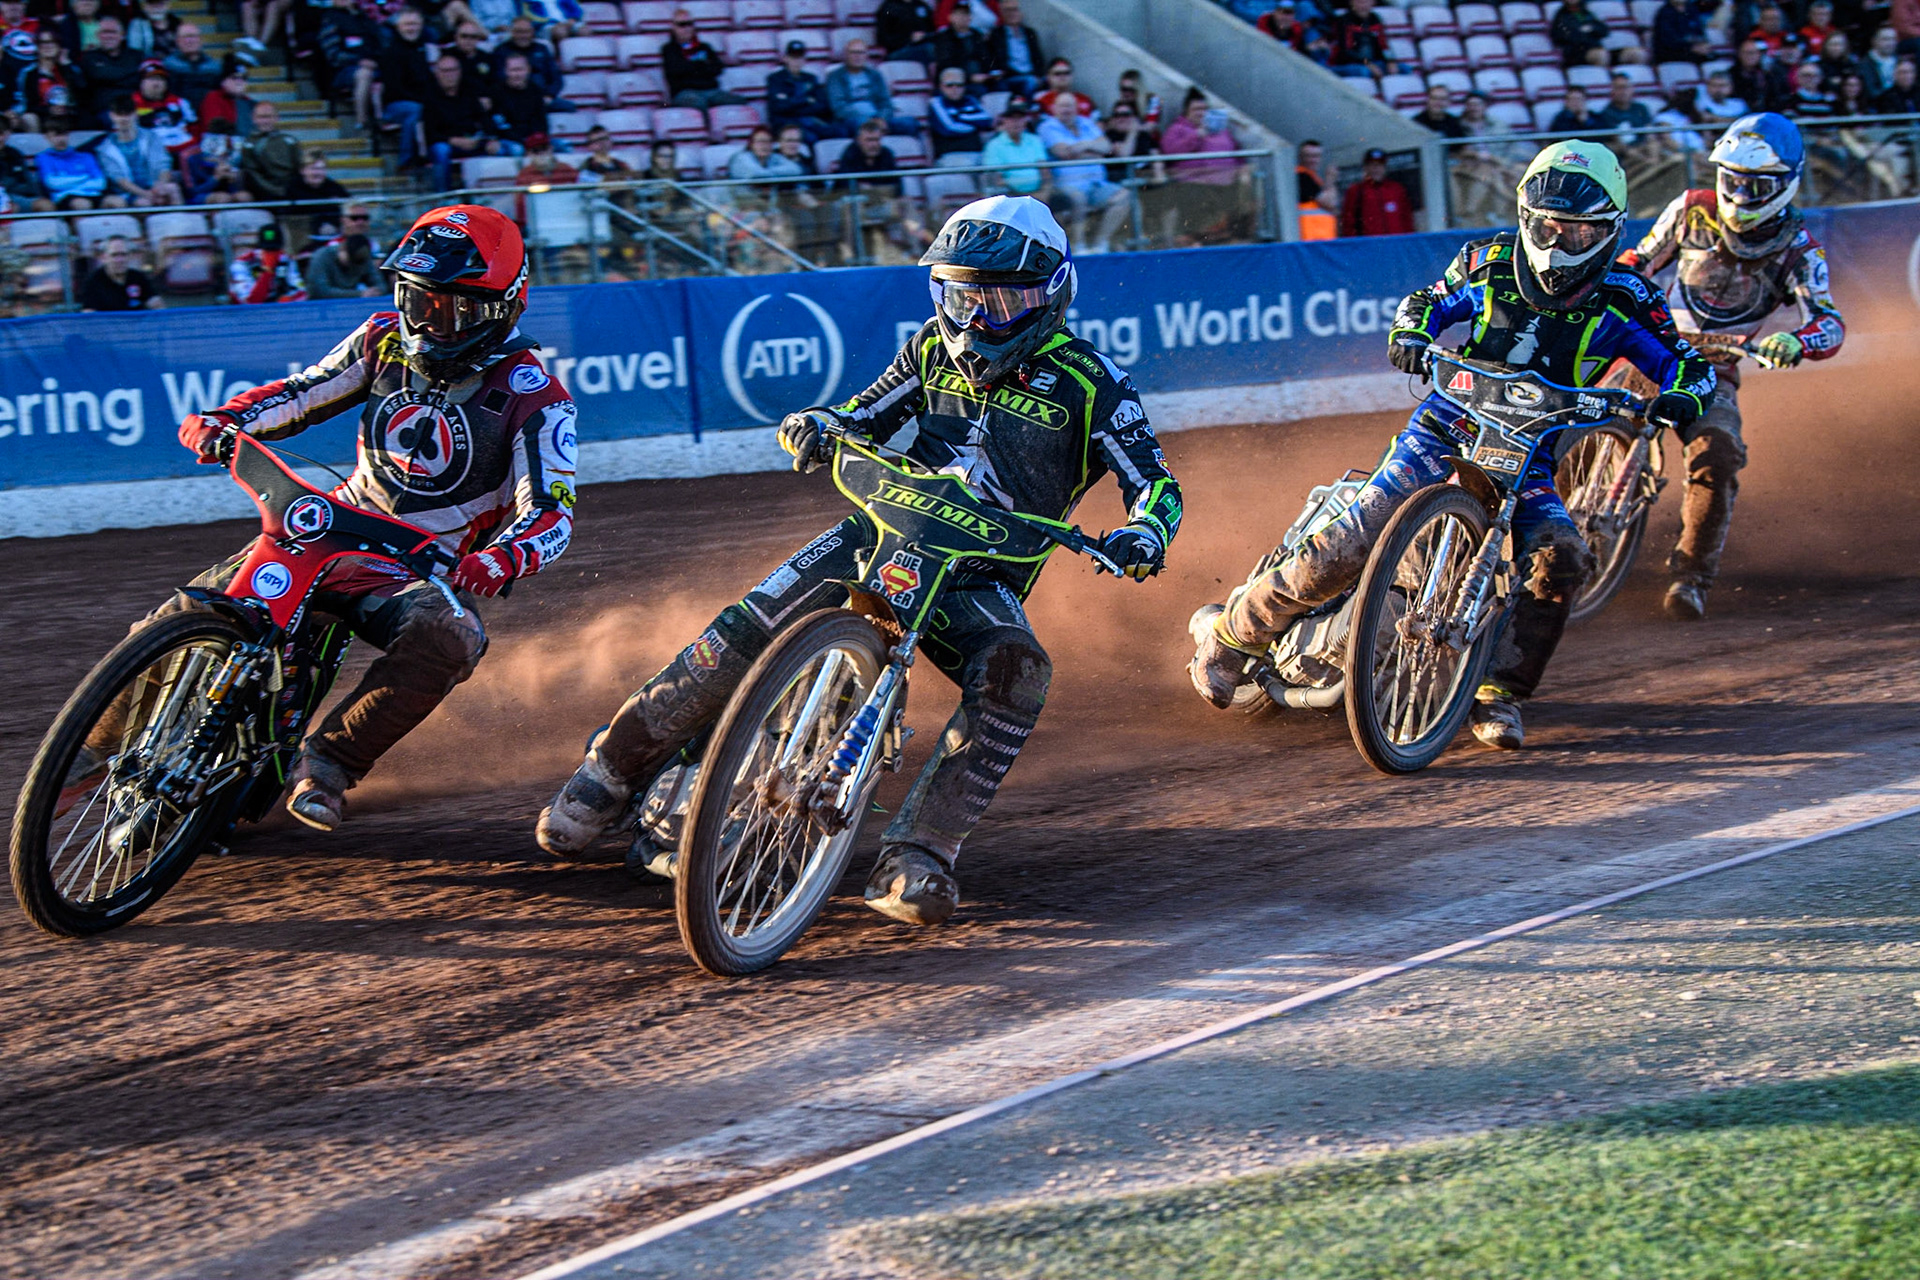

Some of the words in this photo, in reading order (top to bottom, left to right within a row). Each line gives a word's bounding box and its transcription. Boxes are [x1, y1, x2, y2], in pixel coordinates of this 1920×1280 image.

[1469, 244, 1515, 271] LUCA
[1155, 292, 1293, 349] World
[1304, 288, 1400, 337] Clas
[531, 336, 688, 396] Travel
[743, 336, 822, 379] ATPI
[1030, 372, 1056, 392] 2
[994, 387, 1058, 424] MIX
[384, 393, 421, 416] BELLE
[447, 415, 467, 451] ACES
[1404, 435, 1426, 456] STEVE
[1481, 449, 1524, 461] WATLING
[1476, 455, 1519, 471] JCB
[883, 485, 938, 511] TRU
[935, 504, 998, 538] MIX
[797, 536, 843, 569] GLASS
[893, 552, 921, 571] SUE
[258, 571, 285, 590] ATPI
[872, 580, 913, 608] BER
